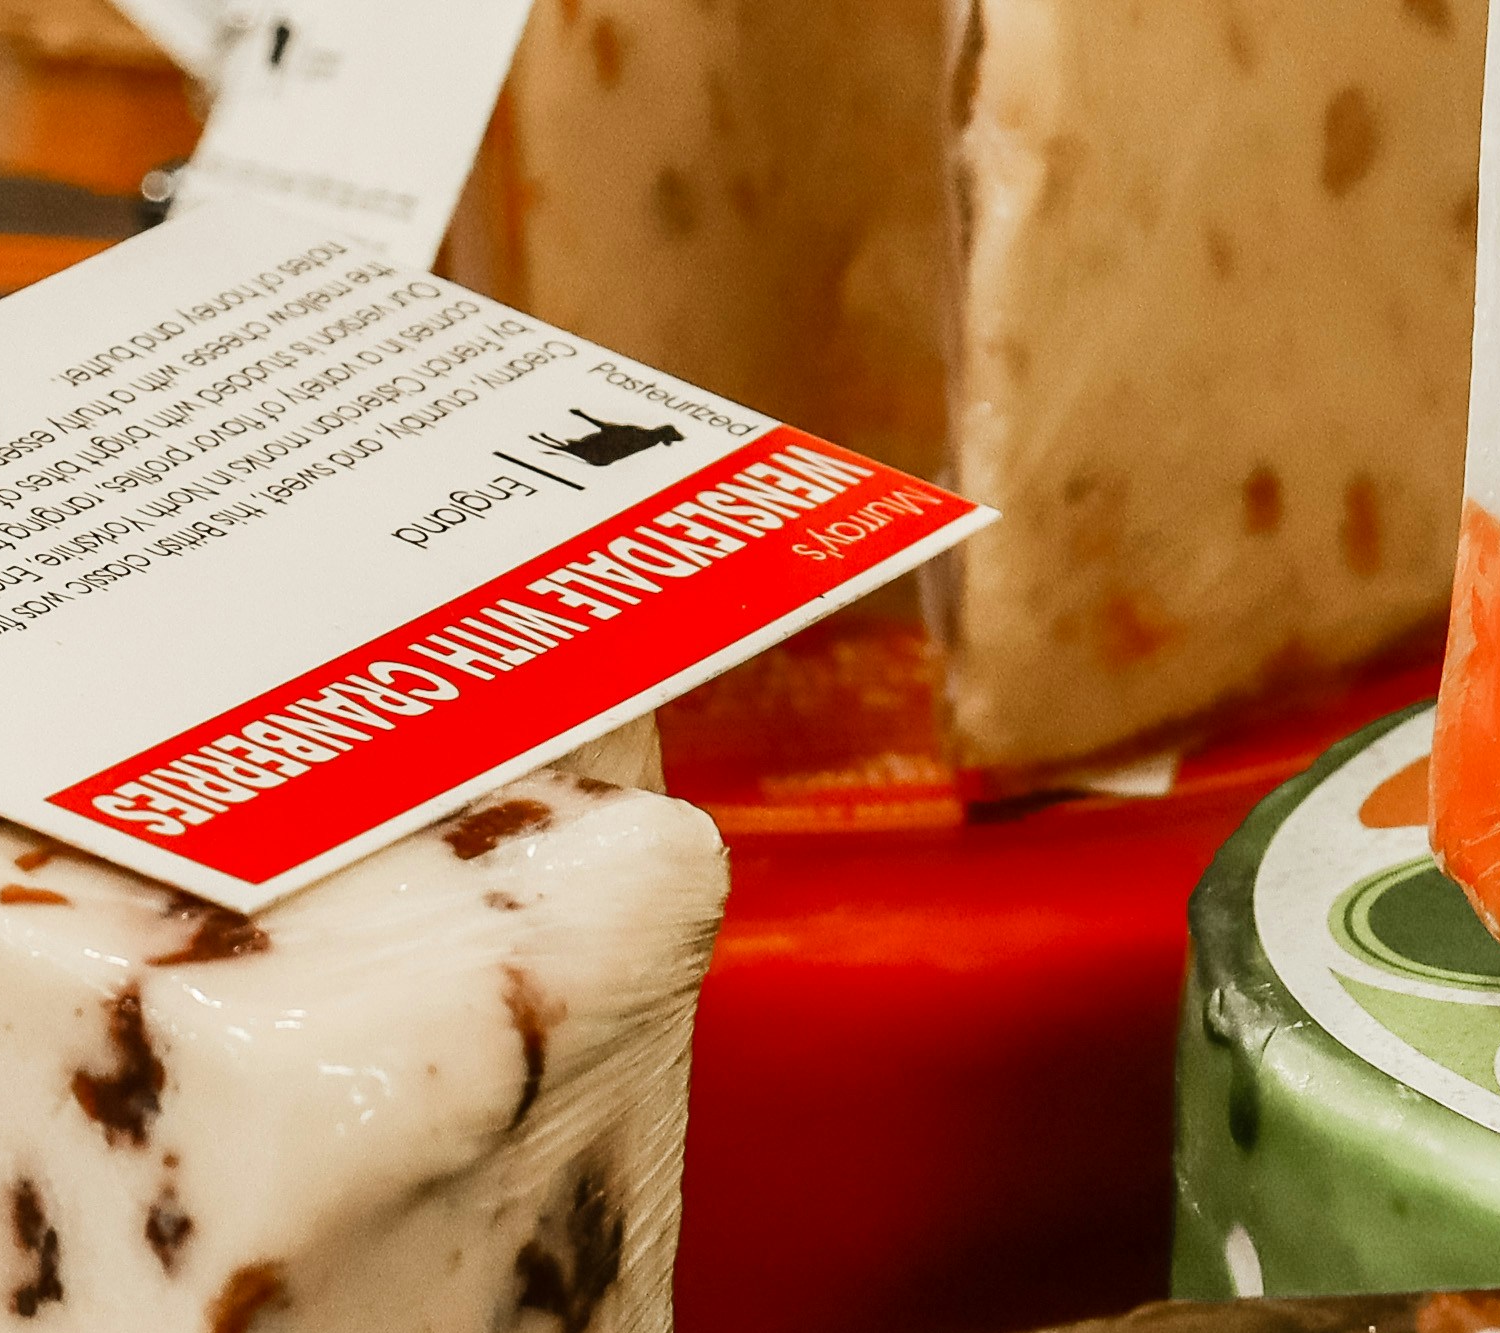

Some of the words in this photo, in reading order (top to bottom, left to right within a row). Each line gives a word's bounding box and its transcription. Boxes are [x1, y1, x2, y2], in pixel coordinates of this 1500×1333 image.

[353, 350, 383, 365] a
[375, 337, 405, 354] in
[275, 361, 357, 405] variety
[252, 400, 286, 423] of
[302, 375, 426, 435] Cistercian
[374, 388, 479, 440] crumbly,
[186, 413, 266, 453] flavor
[225, 430, 311, 474] monks
[325, 437, 383, 470] and
[93, 444, 195, 493] profiles,
[201, 468, 237, 486] in
[248, 462, 337, 505] sweet,
[135, 481, 220, 518] North
[207, 500, 267, 526] this
[389, 475, 538, 550] England
[23, 515, 155, 566] Yorkshire,
[142, 520, 228, 557] British
[523, 444, 874, 621] WENSLEYDALE
[790, 484, 942, 561] Murray's
[63, 553, 151, 595] classic
[10, 590, 74, 619] was
[405, 598, 589, 681] WITH
[89, 660, 459, 836] CRANBERRIES
